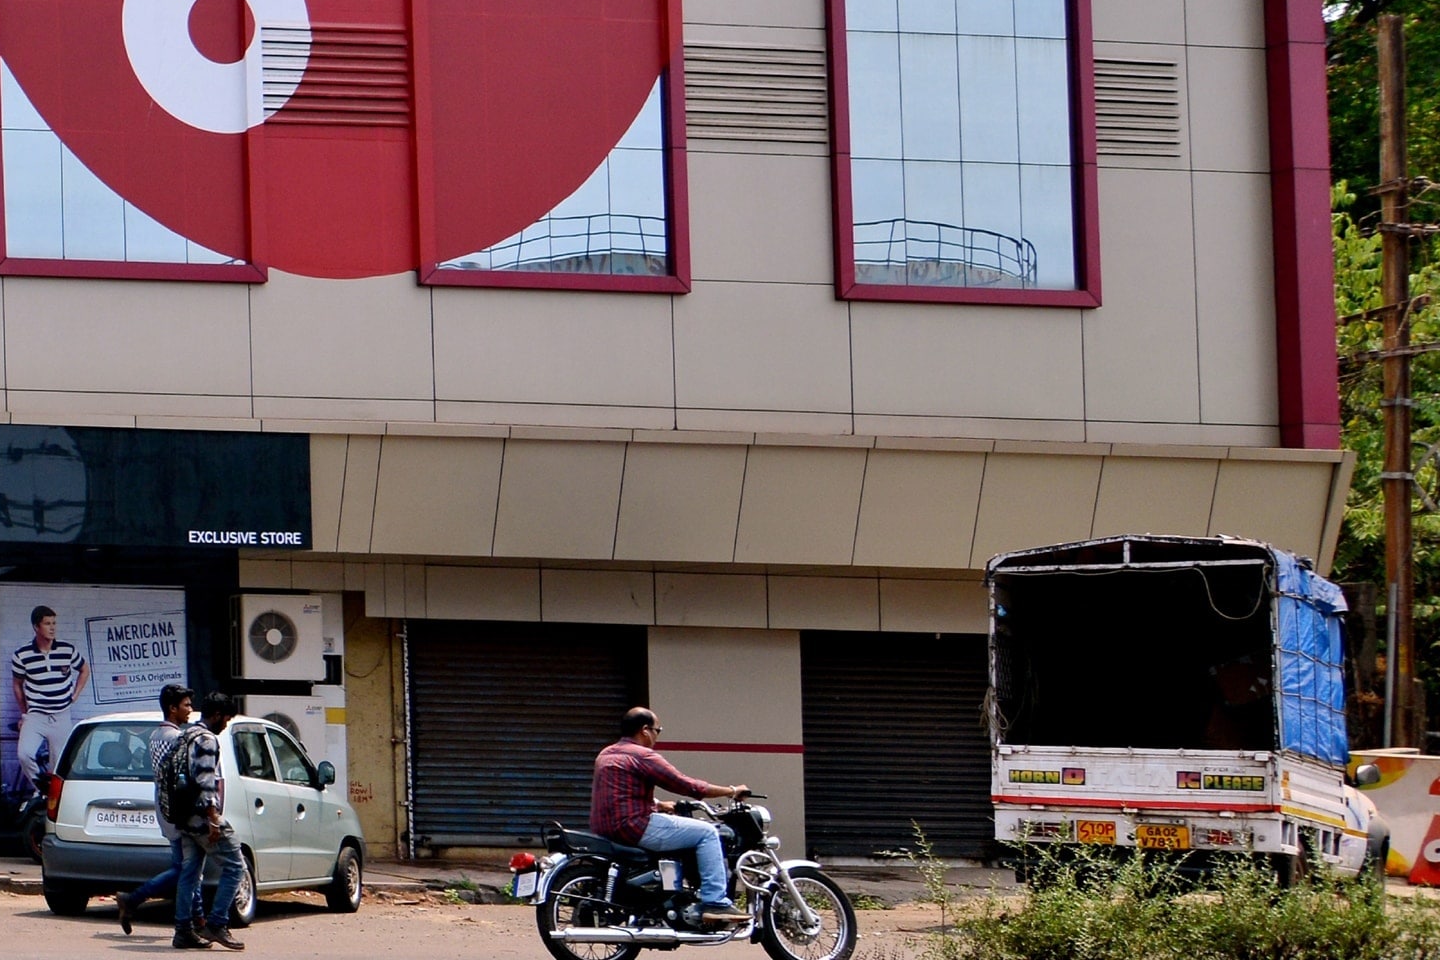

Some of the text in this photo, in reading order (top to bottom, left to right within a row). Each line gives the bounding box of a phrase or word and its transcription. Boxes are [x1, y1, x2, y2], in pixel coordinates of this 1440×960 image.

[188, 530, 302, 545] EXCLUSIVE STORE
[107, 621, 175, 642] AMERICANA
[108, 639, 177, 662] INSIDE OUT
[129, 672, 182, 683] USA Originals
[1010, 770, 1059, 783] HORN
[1204, 775, 1263, 790] PLEASE
[97, 812, 155, 824] GA01 R 4459
[1079, 821, 1114, 838] STOP
[1146, 826, 1178, 837] GA02
